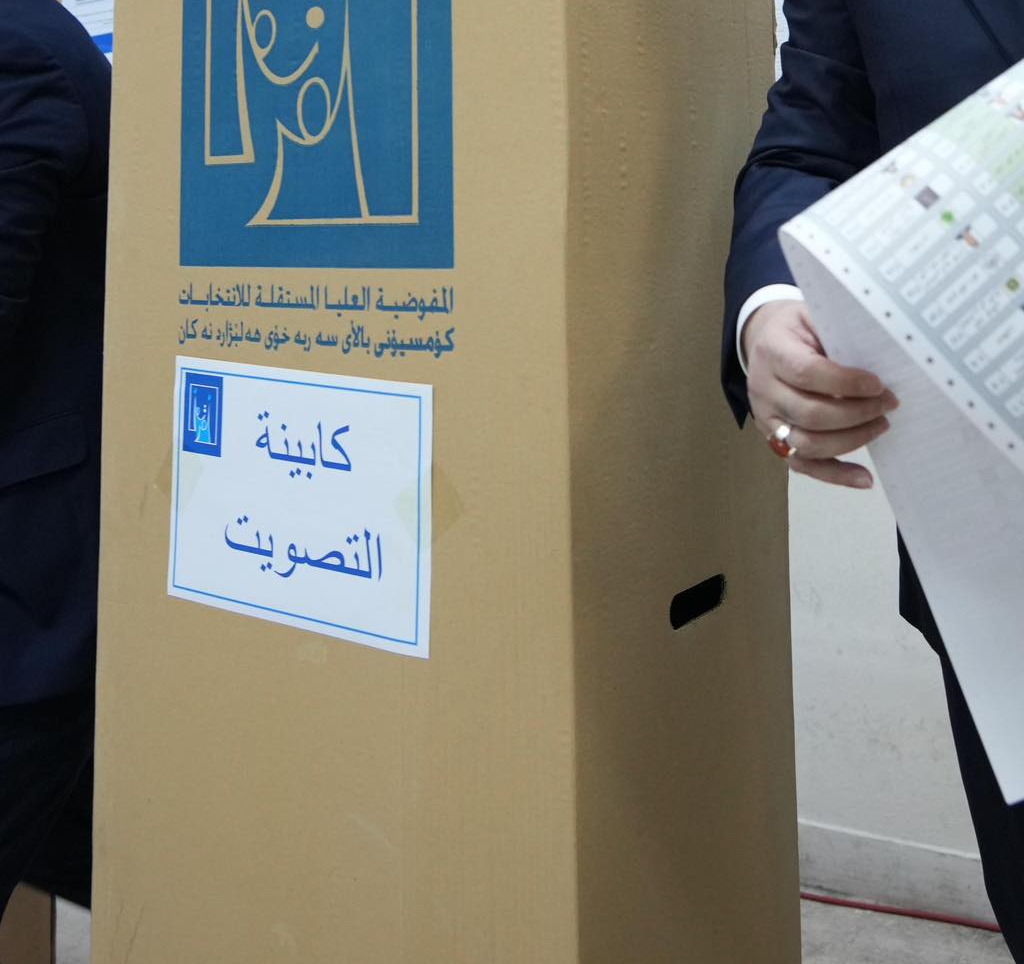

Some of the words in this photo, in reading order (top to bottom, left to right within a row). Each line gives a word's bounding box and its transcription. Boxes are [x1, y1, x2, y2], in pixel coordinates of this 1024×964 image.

[178, 282, 251, 311] للانتخابات
[255, 284, 319, 311] المستقلة
[324, 285, 371, 317] العليا
[375, 286, 454, 321] المفوضية
[255, 410, 352, 480] كابينة
[224, 515, 383, 582] التصويت
